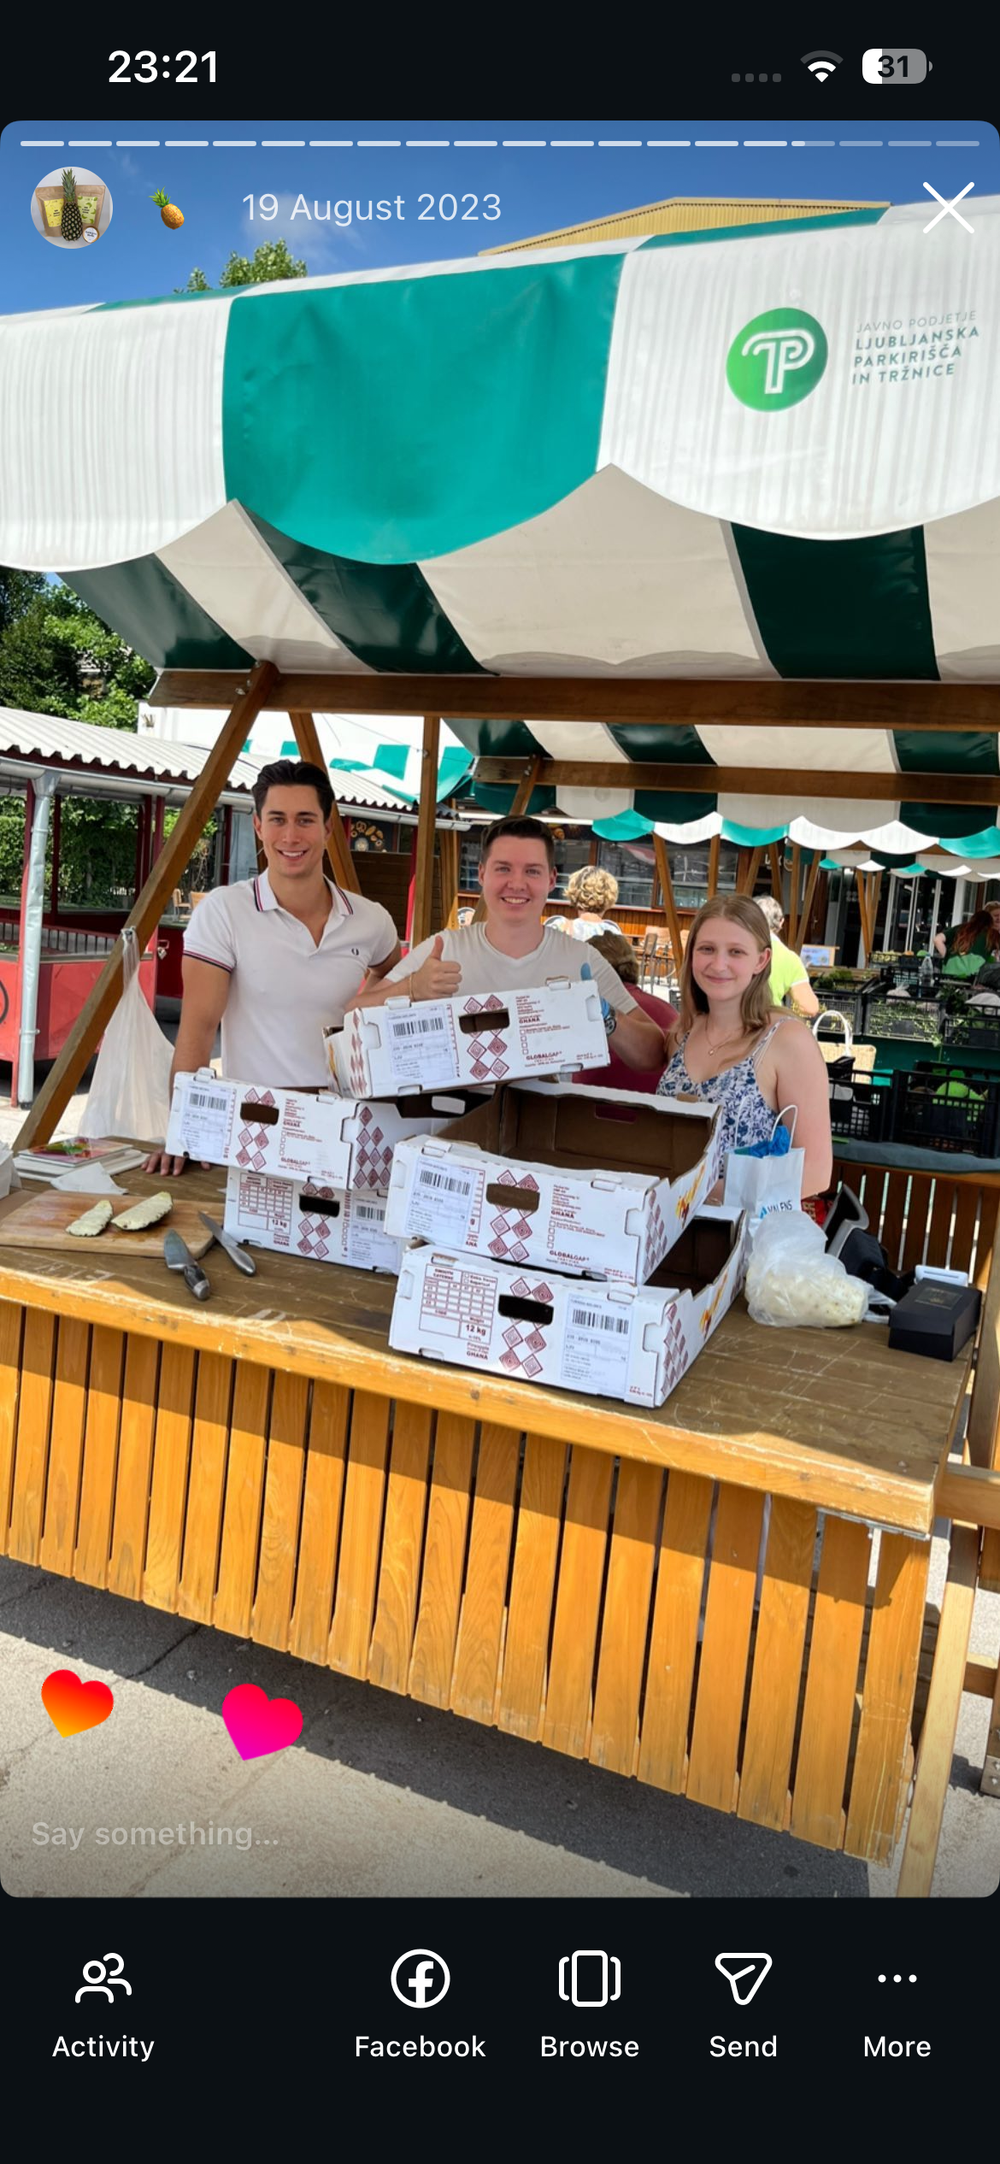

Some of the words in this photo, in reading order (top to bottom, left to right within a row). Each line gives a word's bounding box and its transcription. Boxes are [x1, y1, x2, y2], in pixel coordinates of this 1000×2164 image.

[856, 319, 903, 334] JAVNO
[909, 310, 978, 329] PODJETJE
[856, 326, 980, 350] LJUBLJANSKA
[853, 345, 962, 368] PARKIRIŠČA
[852, 373, 870, 385] IN
[879, 363, 955, 383] TRŽNICE
[551, 1209, 575, 1219] GHANA
[466, 1324, 475, 1333] 12
[476, 1326, 487, 1337] kg
[466, 1351, 488, 1360] GHANA
